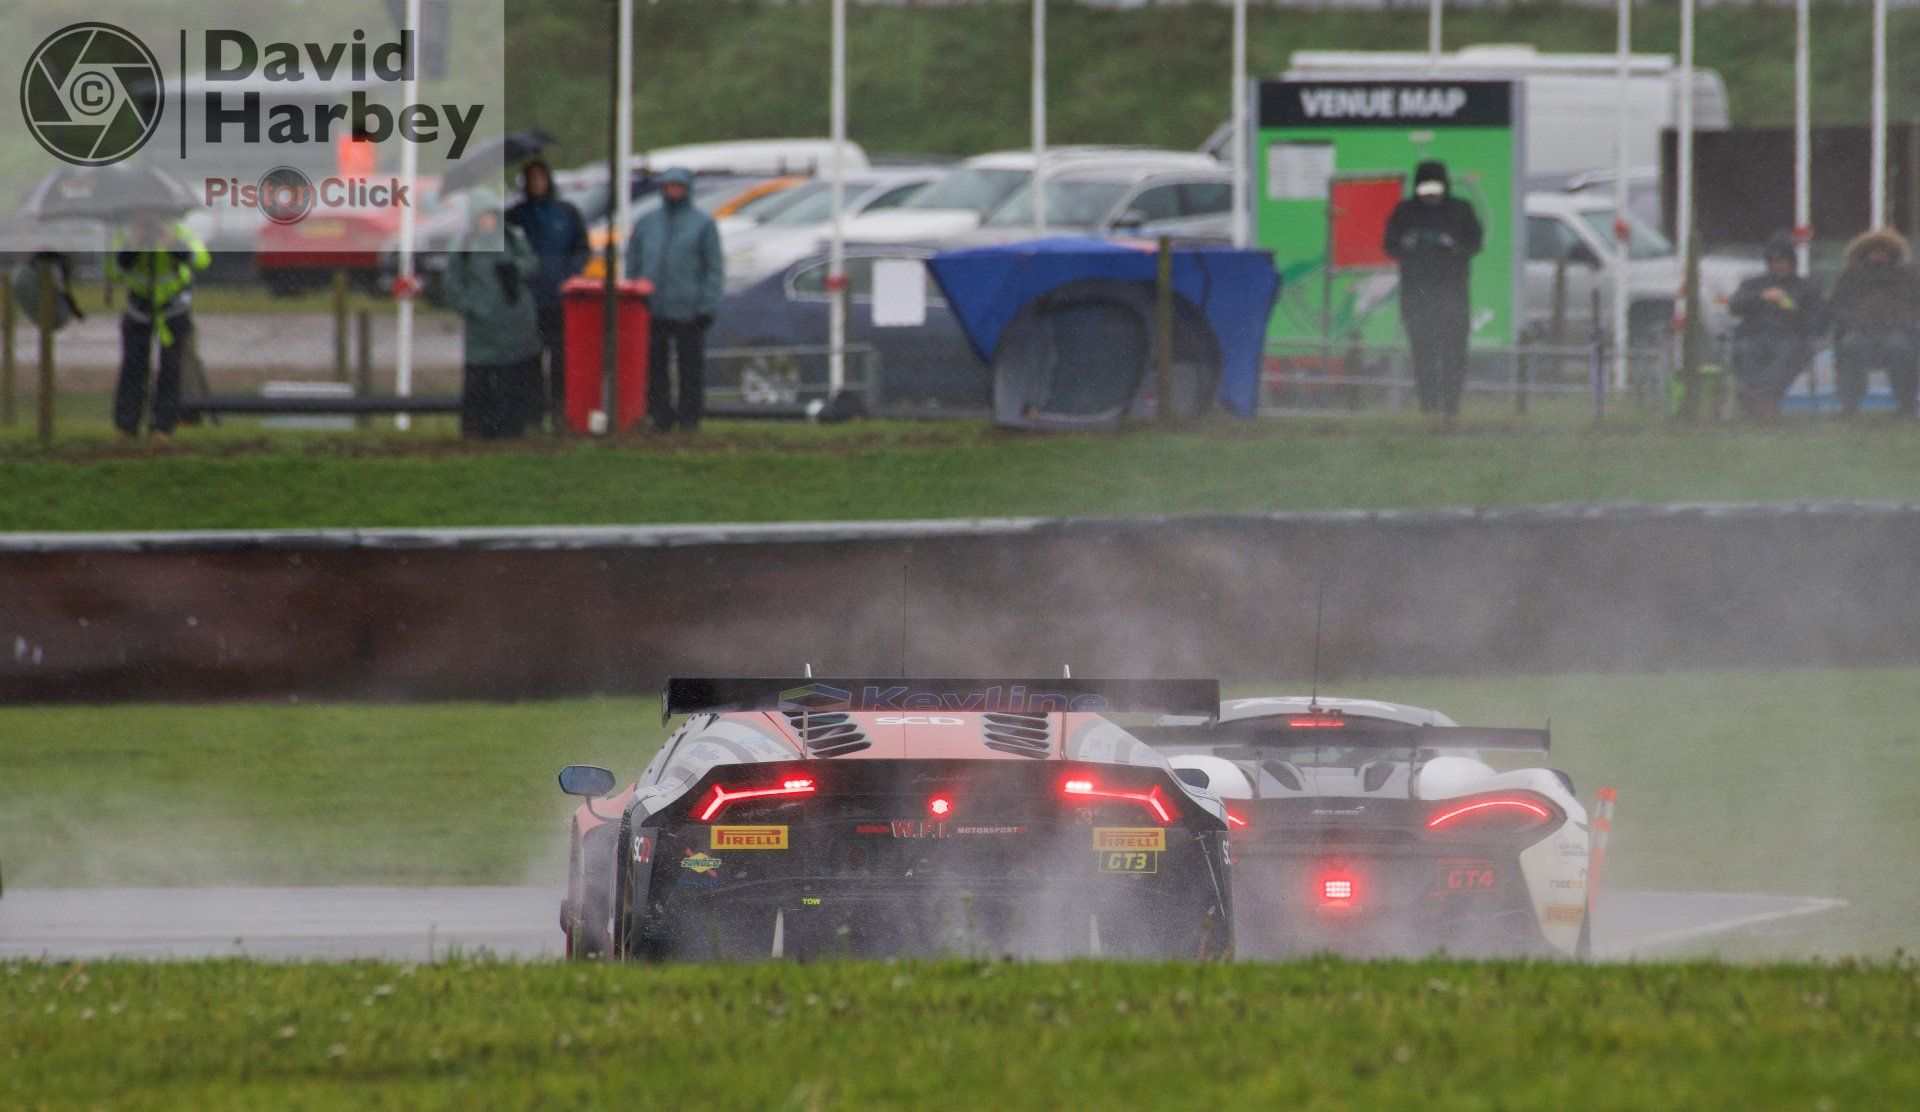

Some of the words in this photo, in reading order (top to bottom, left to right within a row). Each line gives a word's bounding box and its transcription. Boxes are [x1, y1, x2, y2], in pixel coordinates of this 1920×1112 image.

[1300, 87, 1396, 118] VENUE
[1399, 87, 1467, 117] MAP
[717, 829, 781, 846] PIRELLI
[957, 826, 1019, 834] MOTORSPORT
[1100, 831, 1160, 847] PIRELLI
[681, 857, 722, 868] SUNOCO
[1107, 852, 1148, 870] GT3
[1446, 868, 1496, 890] GT4
